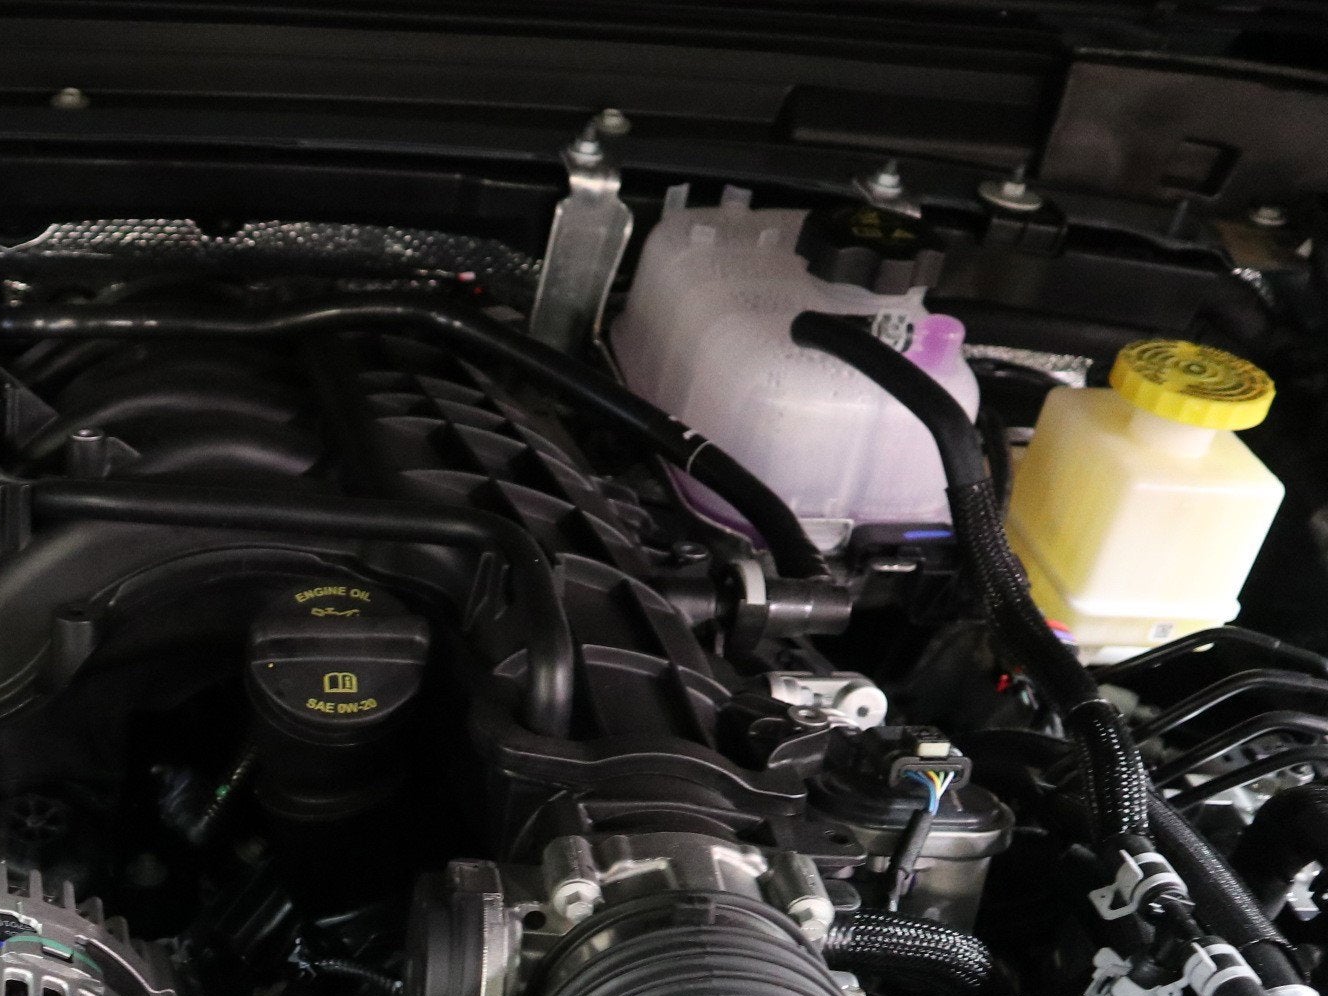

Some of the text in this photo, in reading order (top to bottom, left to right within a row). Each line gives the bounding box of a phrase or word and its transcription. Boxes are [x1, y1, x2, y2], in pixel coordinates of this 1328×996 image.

[294, 586, 372, 603] ENGINE OIL
[305, 698, 378, 713] SAE 0W-20
